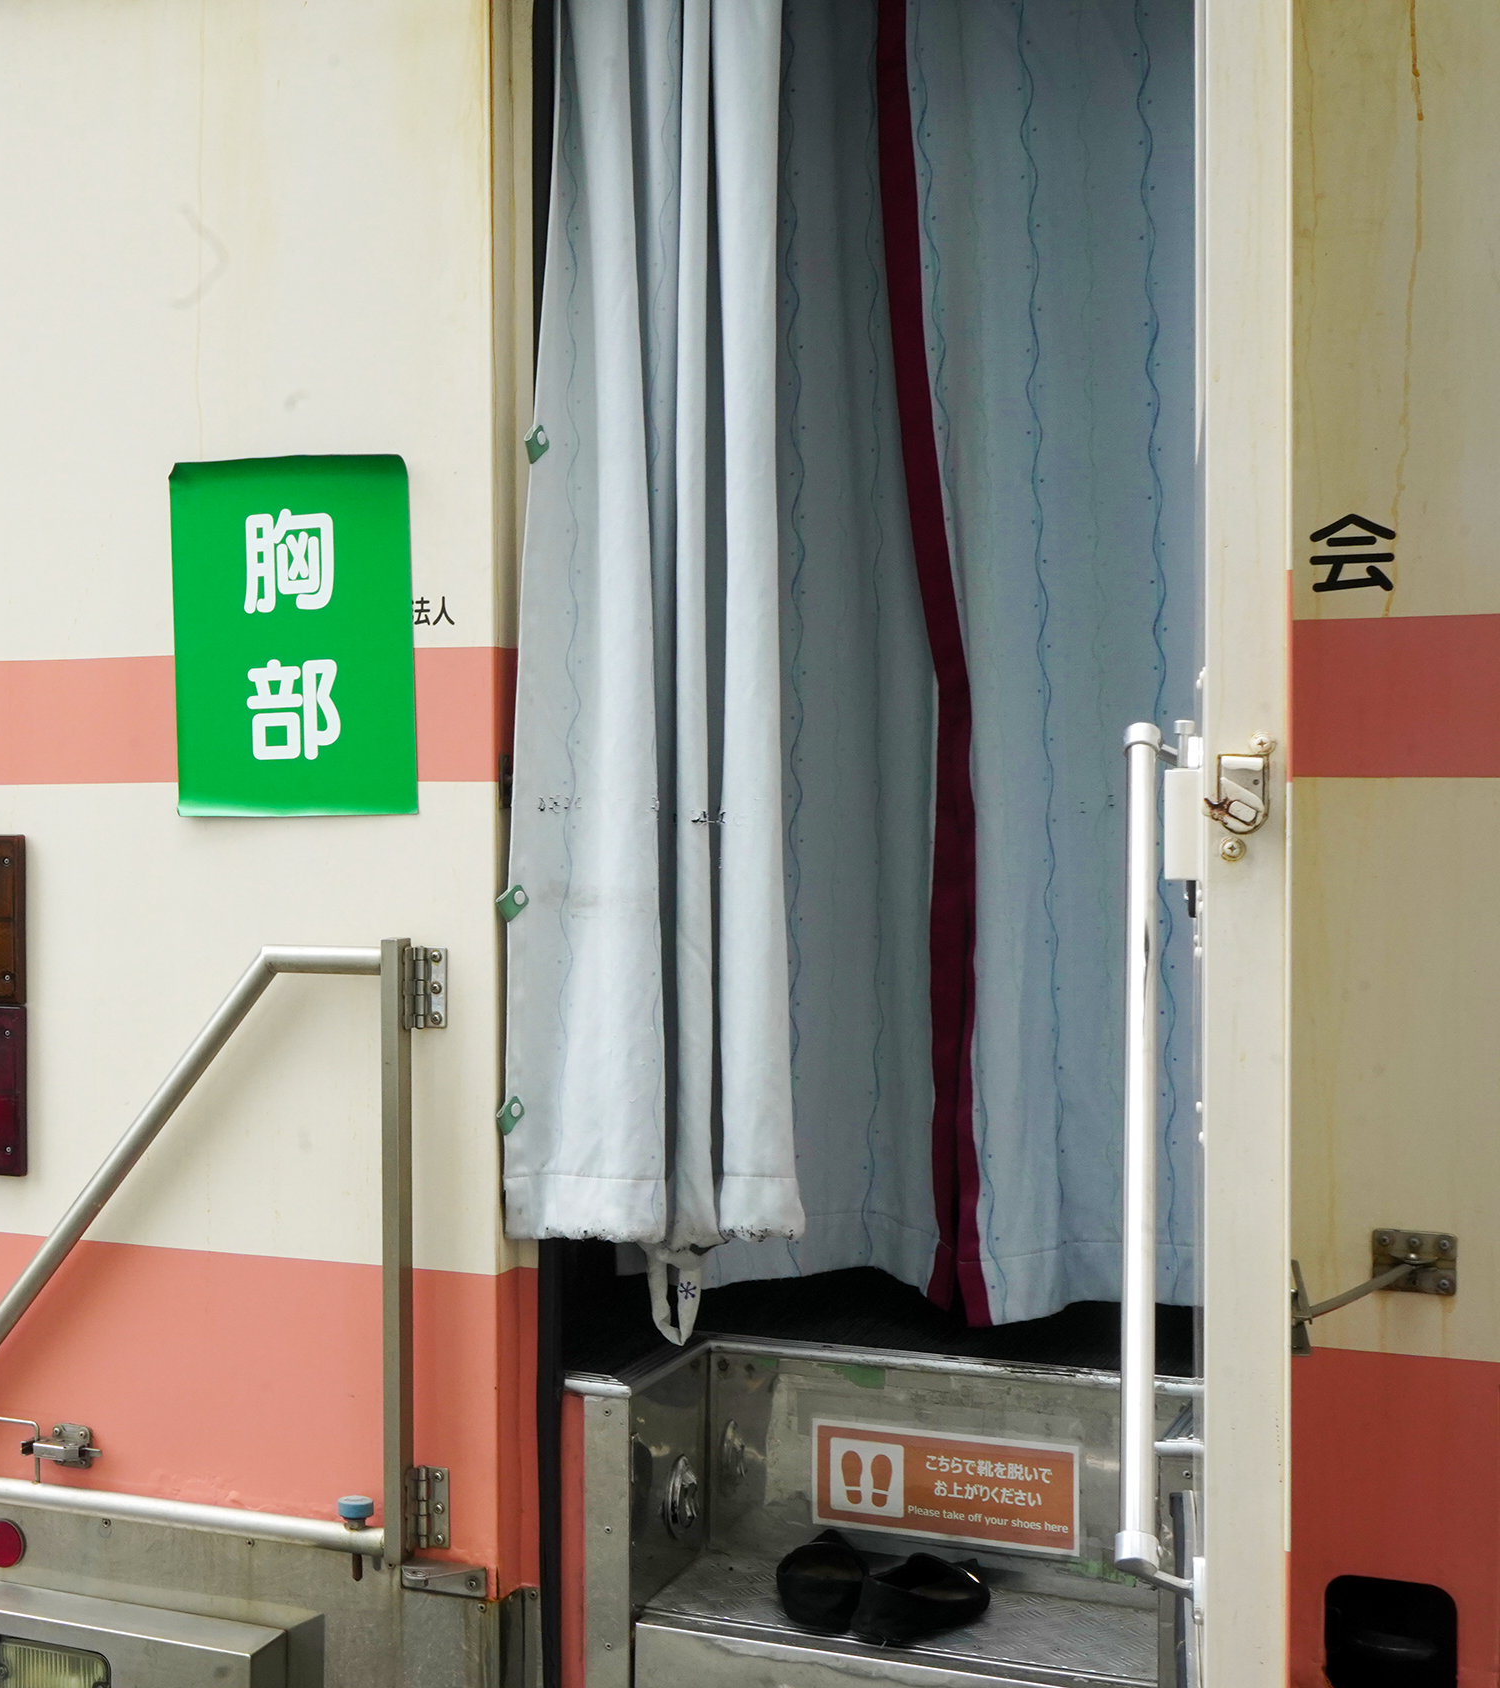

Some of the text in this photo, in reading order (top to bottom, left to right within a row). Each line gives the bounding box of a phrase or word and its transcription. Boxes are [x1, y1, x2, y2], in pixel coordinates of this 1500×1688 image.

[1309, 513, 1396, 592] 会
[244, 508, 341, 761] 胸部
[925, 1455, 1052, 1484] こちらで靴を脱いで
[934, 1480, 1042, 1507] お上がりください
[907, 1504, 1069, 1534] Please take off your shoes here
